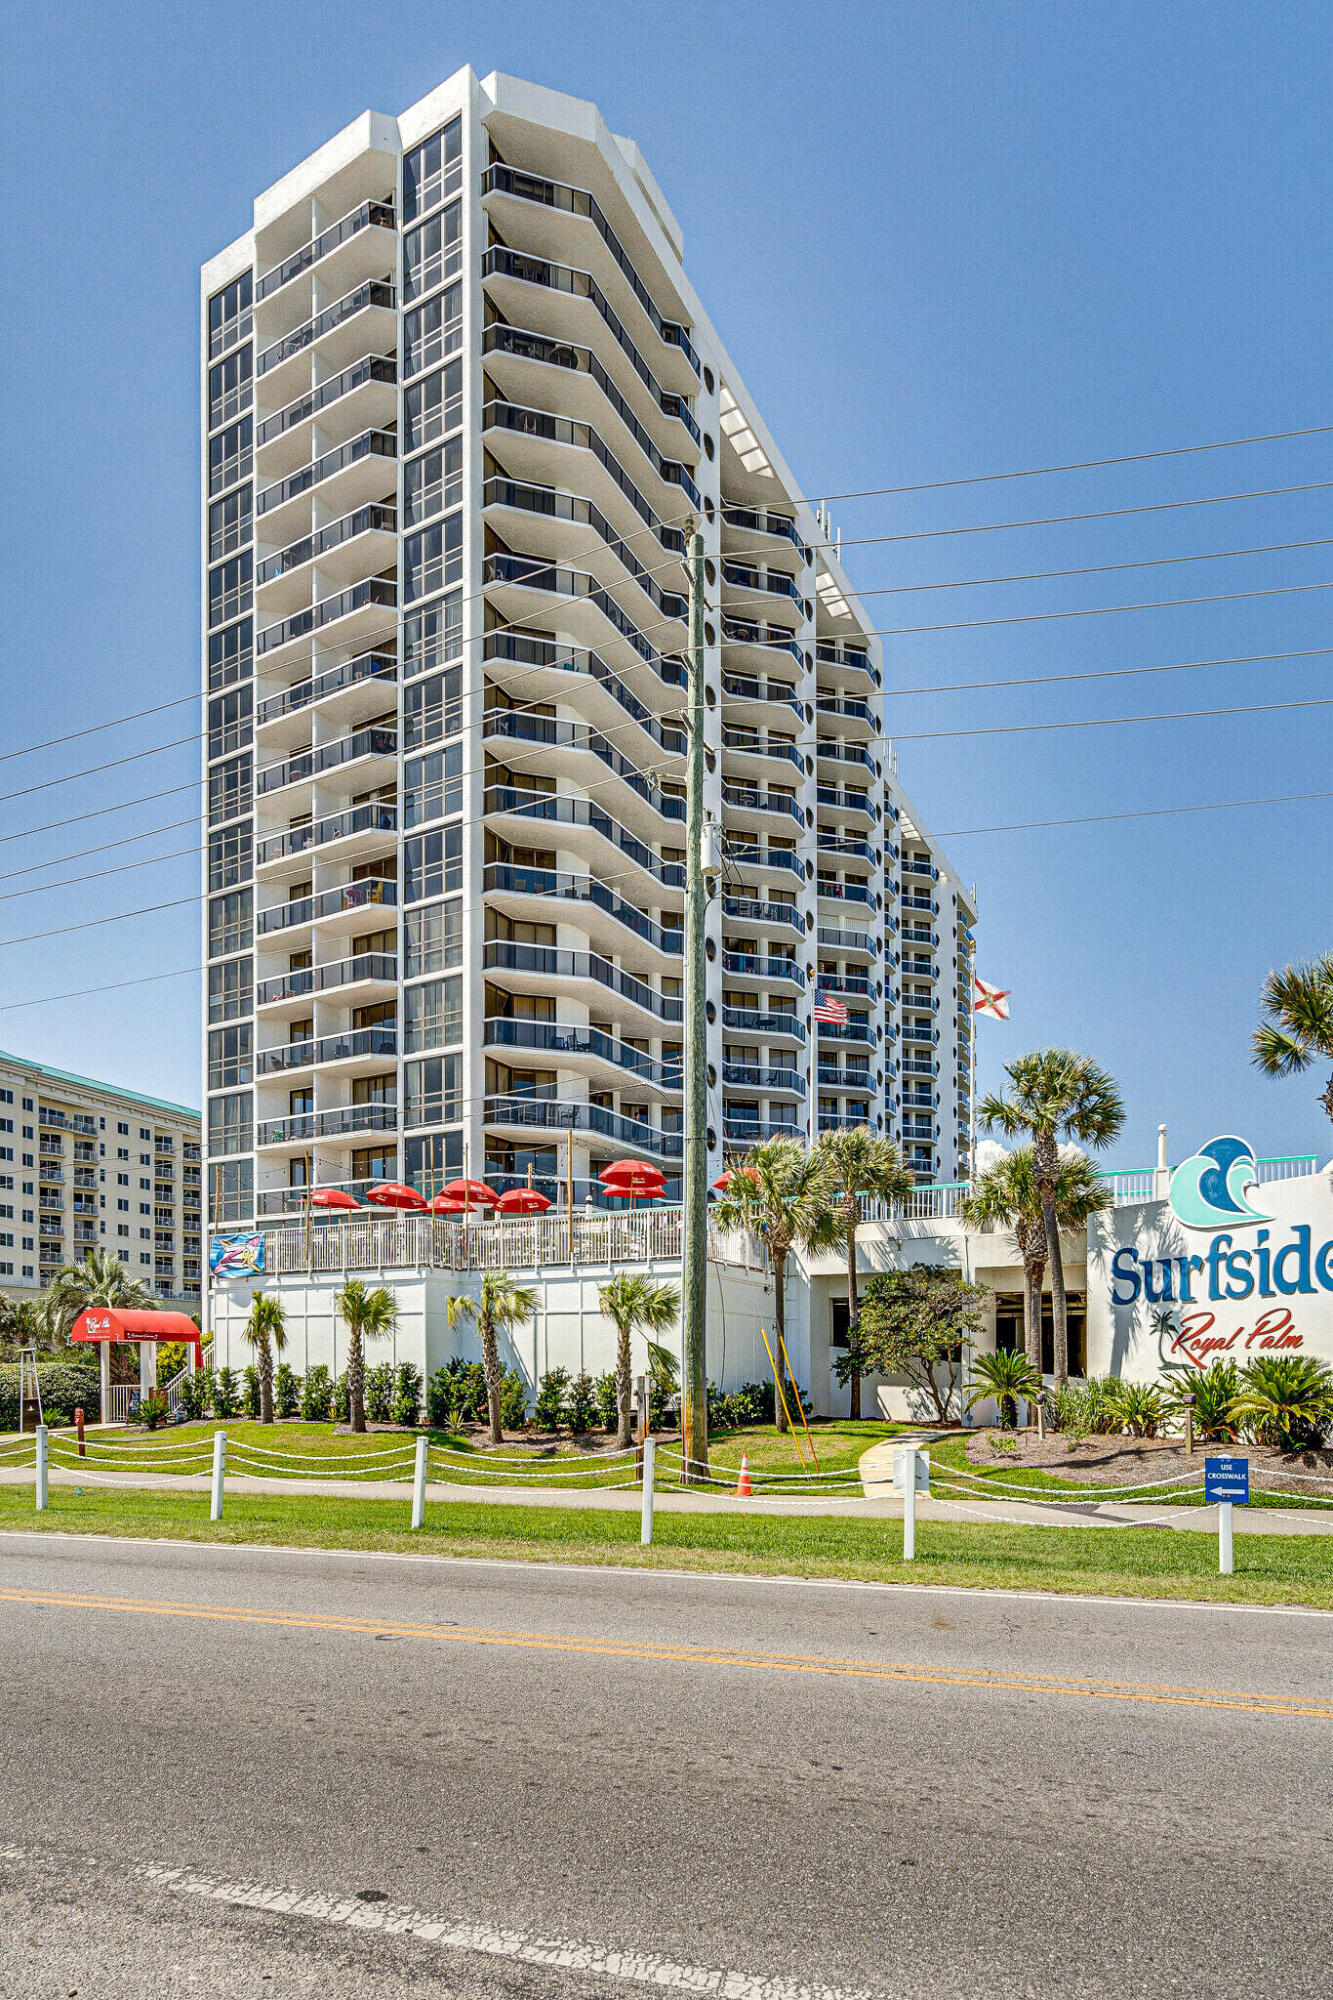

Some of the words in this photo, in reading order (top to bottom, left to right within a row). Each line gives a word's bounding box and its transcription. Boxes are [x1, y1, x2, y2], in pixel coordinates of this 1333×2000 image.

[1171, 1311, 1245, 1370] Royal
[1245, 1308, 1304, 1350] Palm
[1207, 1472, 1247, 1480] CROSSWALK
